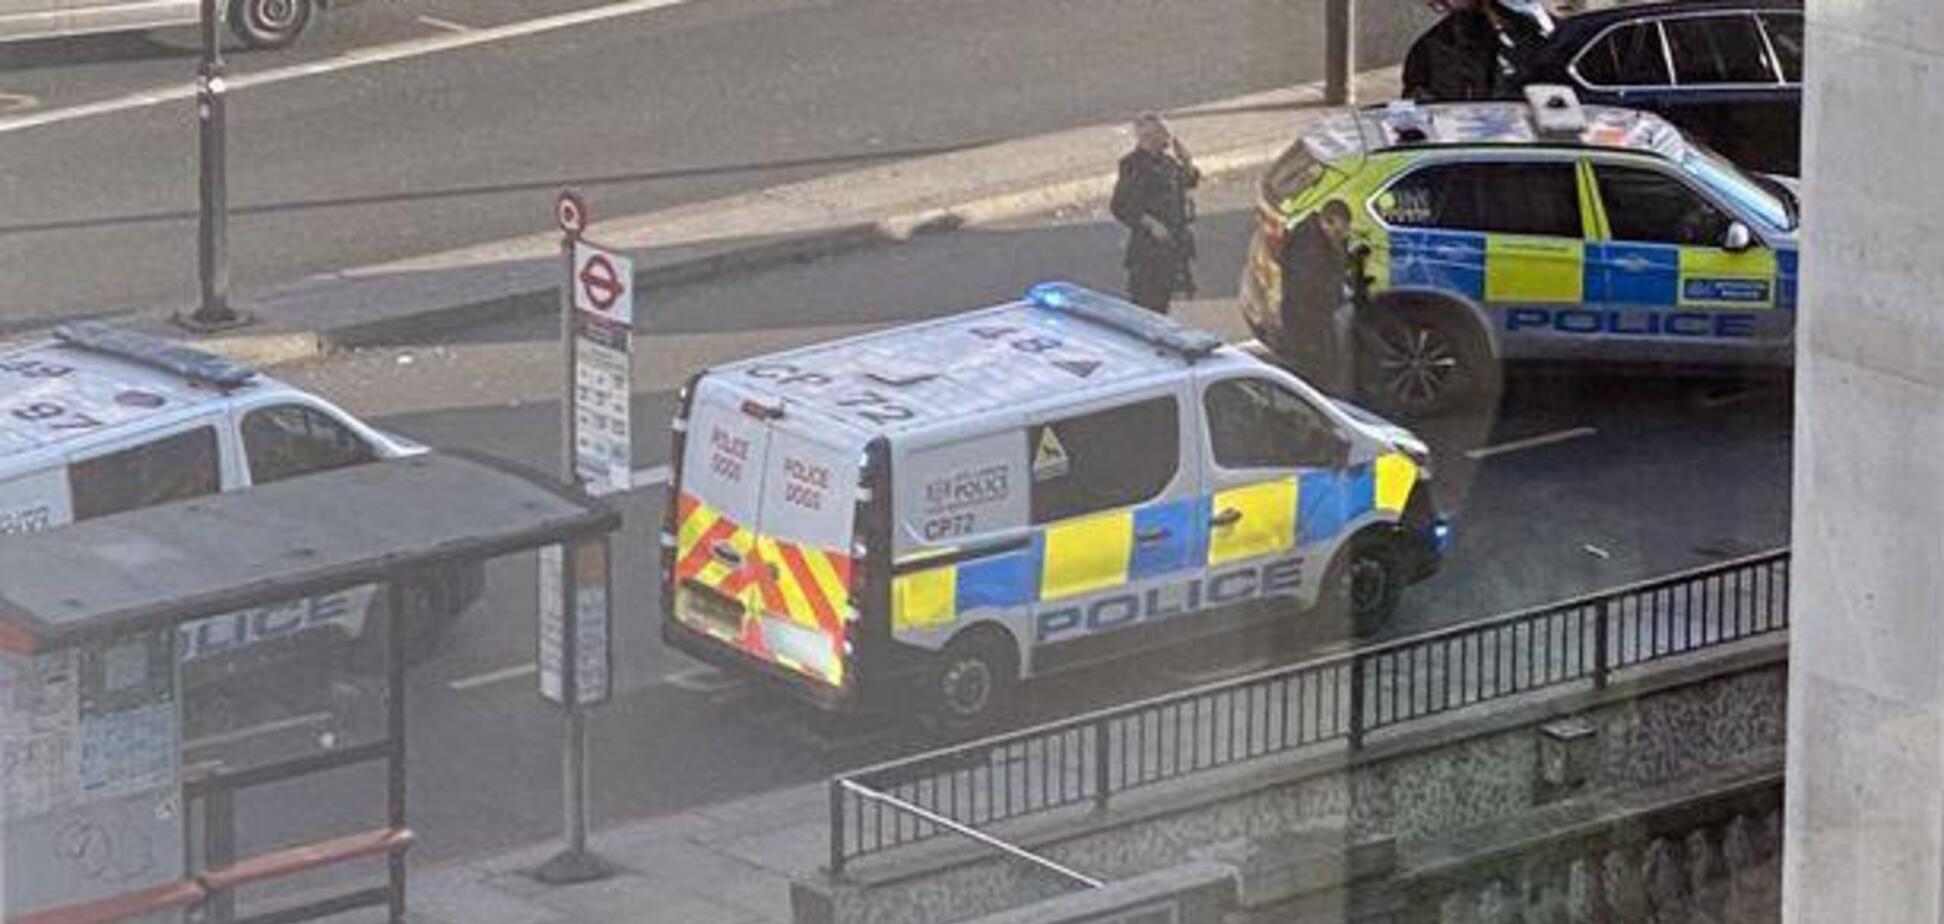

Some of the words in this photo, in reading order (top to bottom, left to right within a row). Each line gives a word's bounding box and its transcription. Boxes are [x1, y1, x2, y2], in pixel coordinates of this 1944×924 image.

[1505, 308, 1756, 336] POLICE
[12, 402, 102, 430] 97
[837, 390, 914, 425] 72
[711, 427, 749, 461] POLICE
[784, 458, 830, 490] POLICE
[925, 512, 974, 541] CP72
[1037, 557, 1304, 640] POLICE
